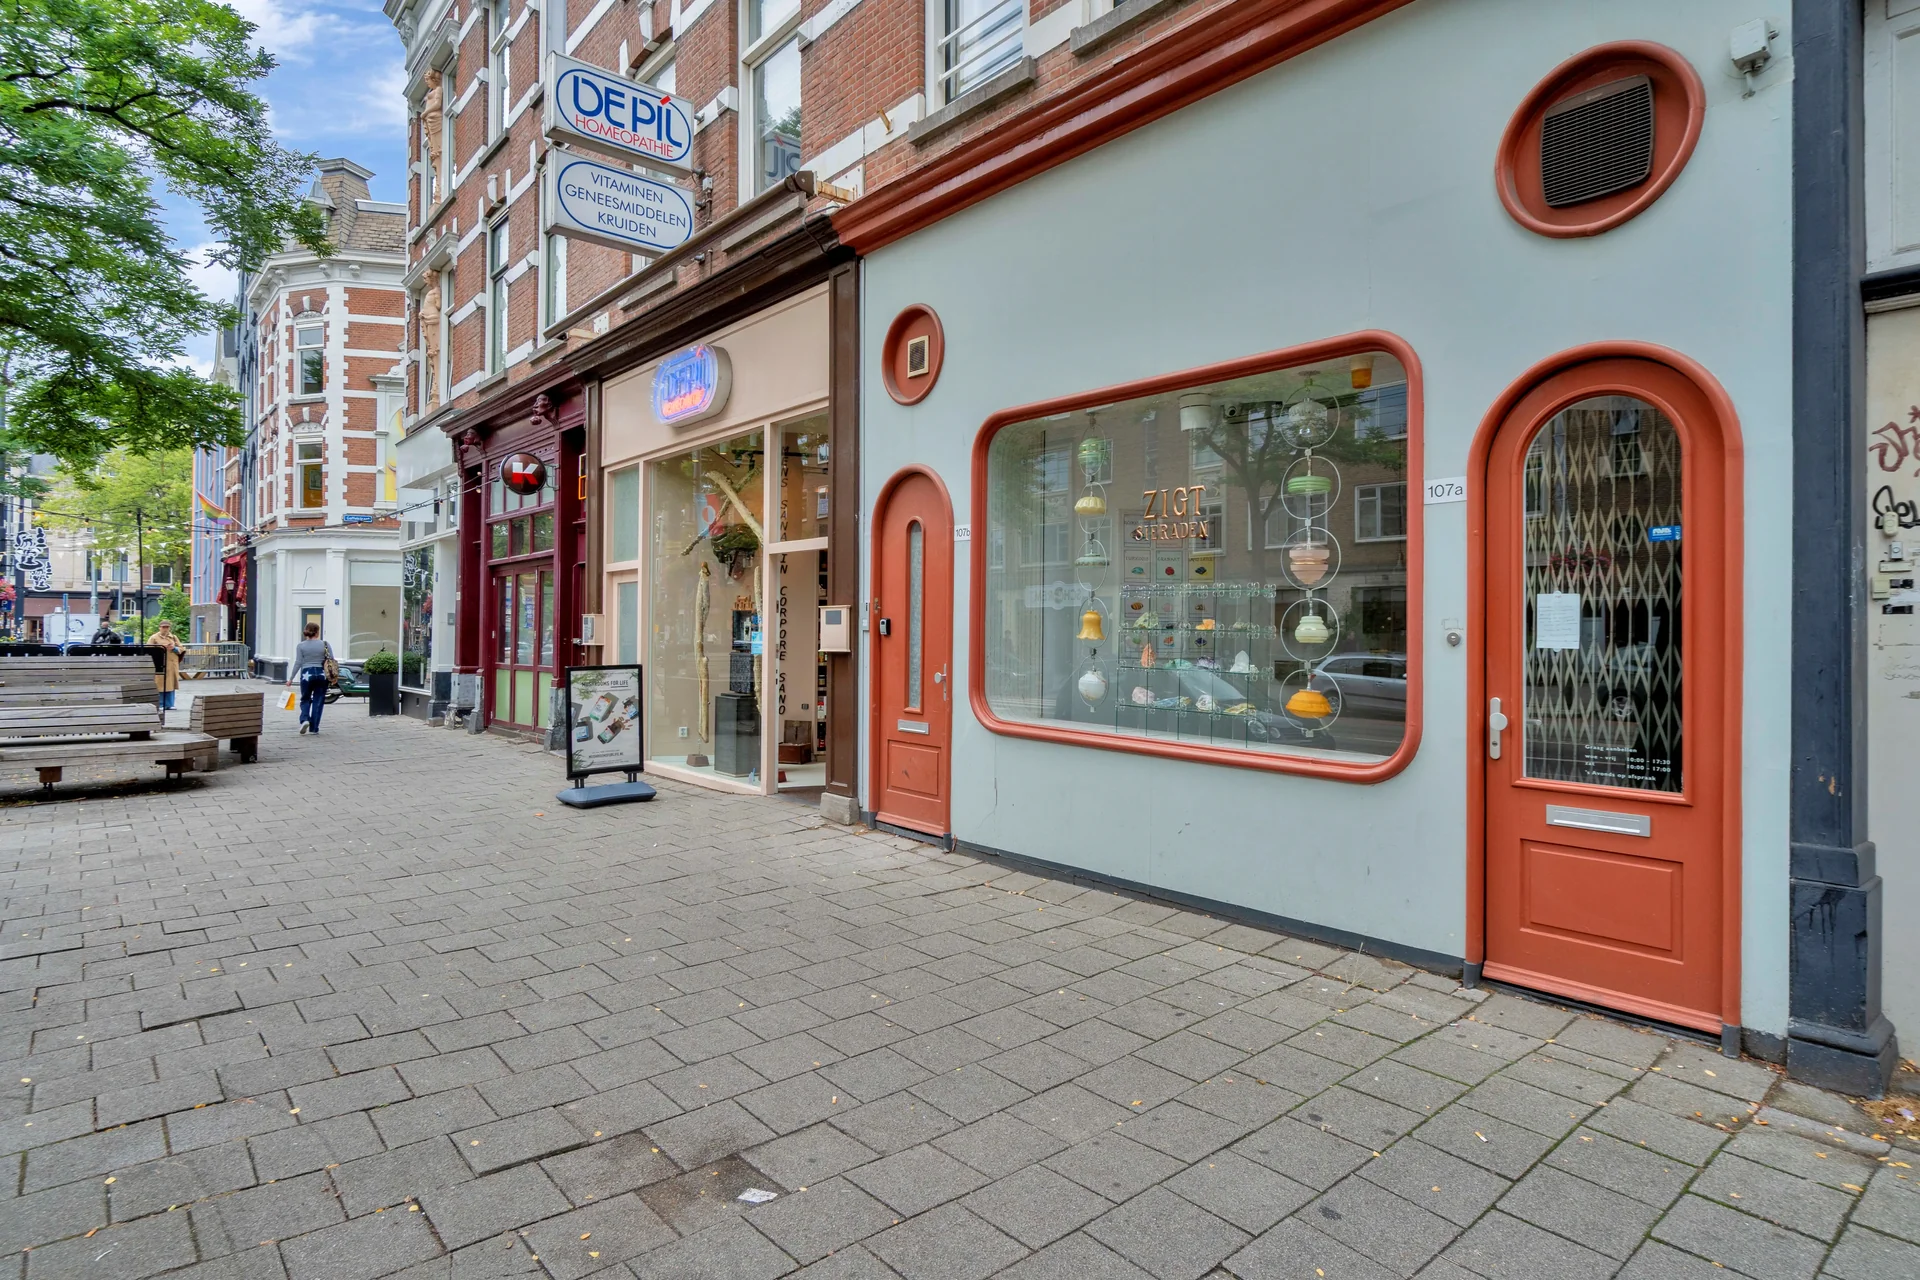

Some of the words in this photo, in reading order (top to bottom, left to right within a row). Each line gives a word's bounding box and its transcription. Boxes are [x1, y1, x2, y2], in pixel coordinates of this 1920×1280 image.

[575, 114, 674, 159] HOMEOPATHIE
[591, 171, 663, 204] VITAMINEN
[565, 183, 686, 228] GENEESMIDDELEN
[598, 211, 656, 238] KRUIDEN
[1143, 485, 1206, 520] ZIGT
[1428, 483, 1463, 498] 107a
[780, 499, 788, 541] SANA
[956, 528, 970, 537] 107b
[1135, 520, 1209, 541] SIERADEN
[780, 553, 788, 574] IN
[779, 586, 788, 661] CORPORE
[778, 672, 787, 716] SANO
[1584, 744, 1604, 752] Graag
